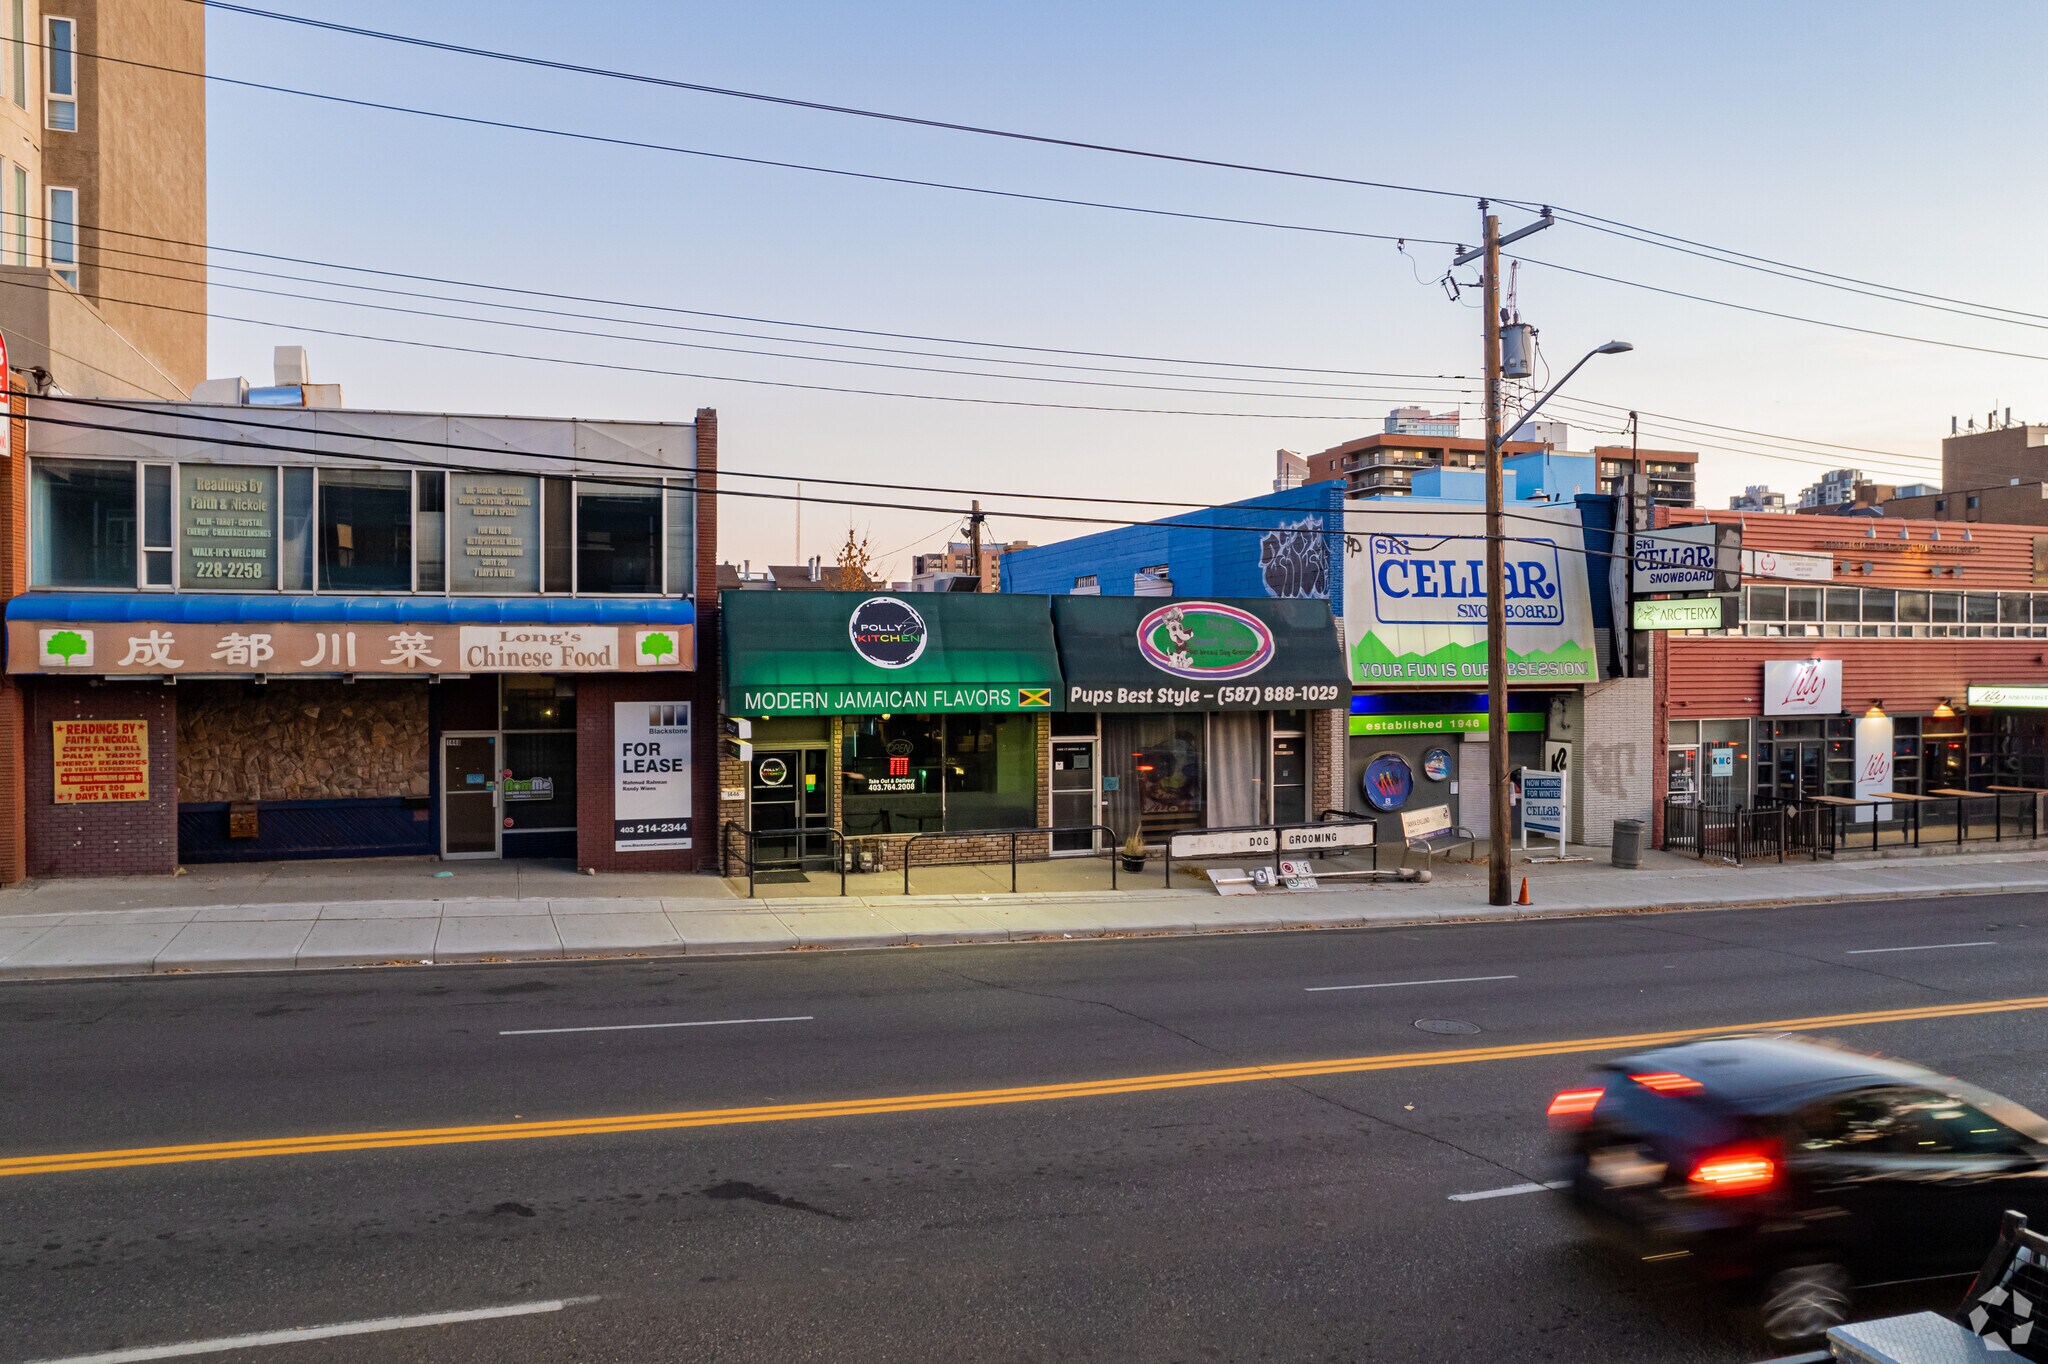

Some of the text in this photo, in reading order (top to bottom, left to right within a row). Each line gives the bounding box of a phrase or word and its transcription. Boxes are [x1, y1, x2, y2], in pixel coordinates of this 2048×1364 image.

[196, 478, 262, 493] Readings By
[191, 497, 267, 511] Faith & Nickole
[231, 549, 266, 558] WELCOME
[196, 562, 262, 578] 228-2258
[1650, 570, 1714, 584] SNOWBOARD
[1660, 607, 1718, 620] ARC'TERYX
[499, 631, 581, 645] Long's
[857, 634, 920, 643] KITCHEN
[117, 629, 443, 669] 成都川菜
[467, 645, 612, 667] Chinese Food
[1361, 662, 1403, 678] YOUR
[1407, 663, 1438, 678] FUN
[1441, 663, 1455, 677] IS
[1500, 661, 1589, 676] BSESSION!
[1782, 665, 1826, 705] Lily
[745, 690, 1011, 709] MODERN JAMAICAN FLAVORS
[1071, 687, 1112, 706] Pups
[1117, 687, 1153, 704] Best
[1157, 687, 1200, 706] Style
[1217, 686, 1261, 705] (587)
[1264, 686, 1338, 702] 888-1029
[1974, 690, 2006, 704] Lily
[66, 723, 135, 734] READINGS BY
[1366, 719, 1480, 731] established 1946
[65, 736, 91, 744] FAITH
[623, 742, 661, 756] FOR
[623, 759, 682, 773] LEASE
[1858, 753, 1890, 783] Lily
[1539, 790, 1561, 798] WINTER
[637, 823, 687, 833] 214-2344
[1250, 833, 1337, 847] DOG GROOMING
